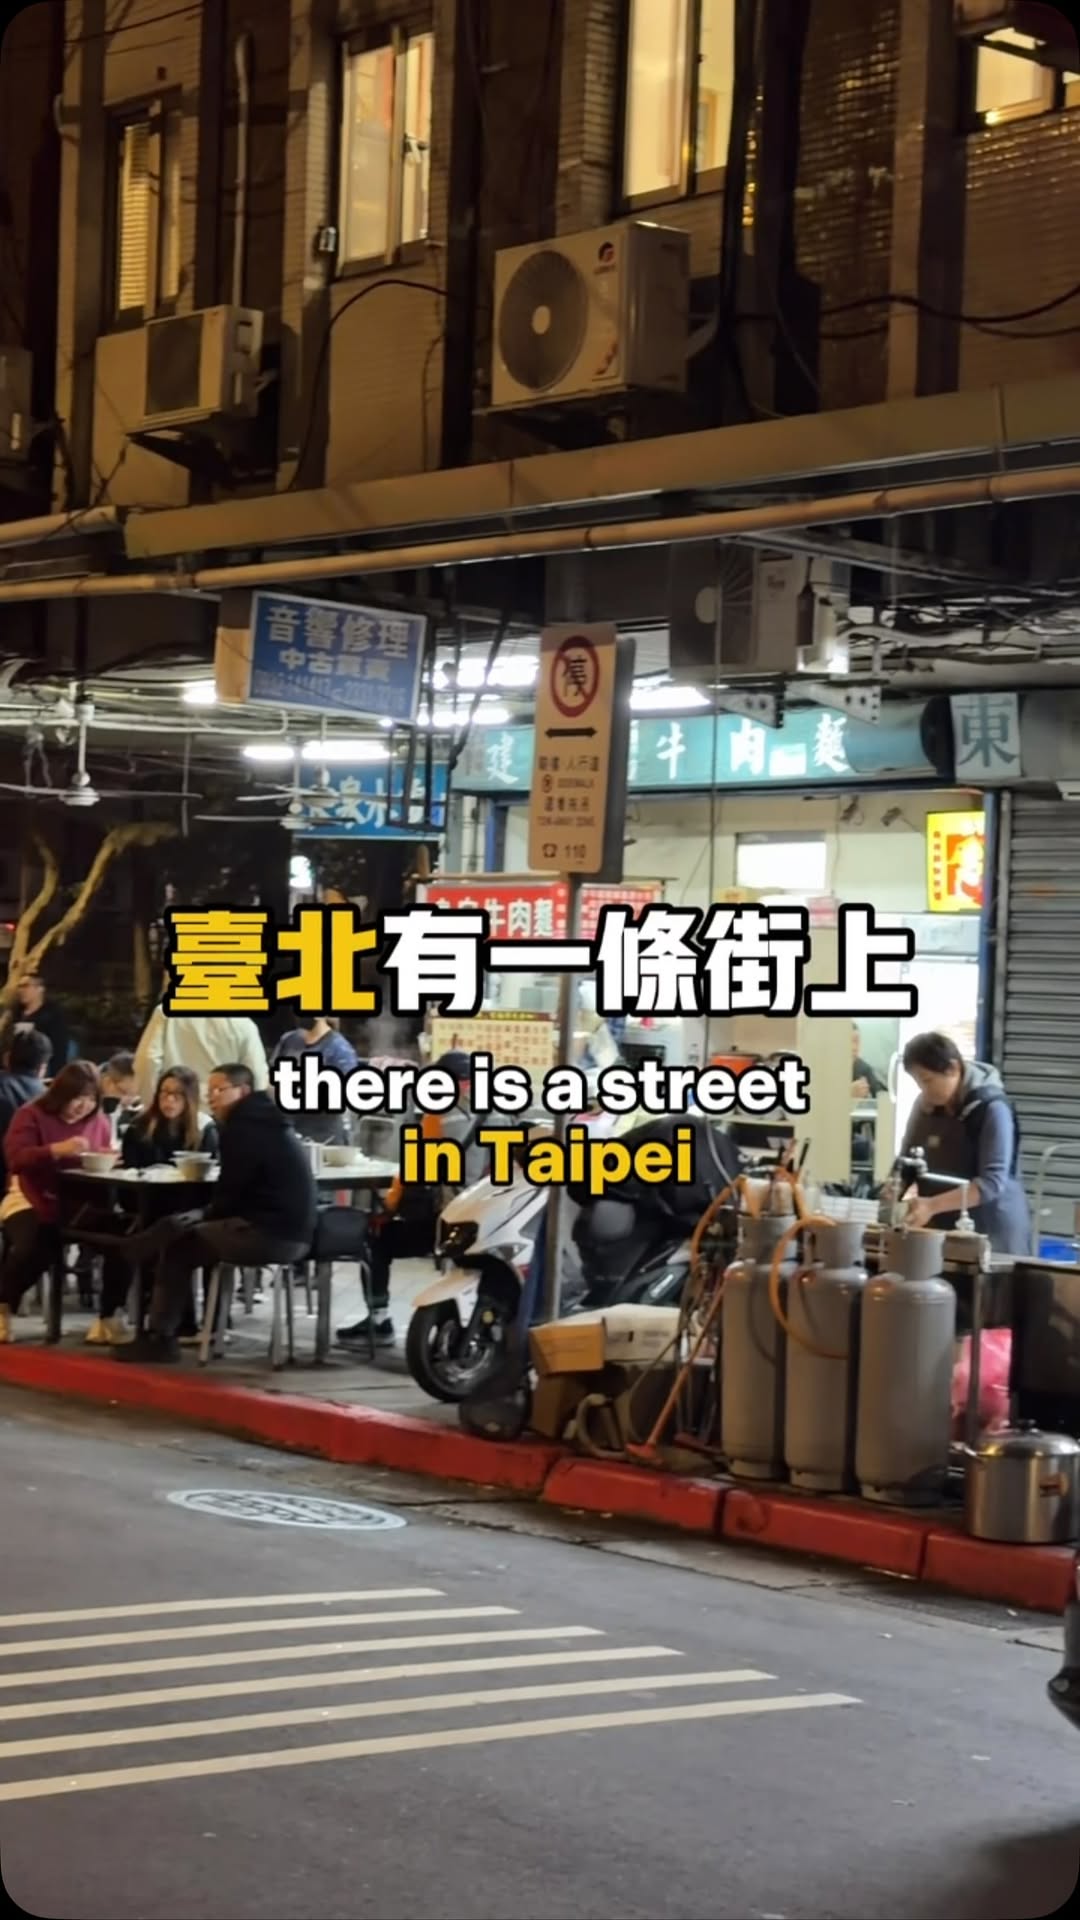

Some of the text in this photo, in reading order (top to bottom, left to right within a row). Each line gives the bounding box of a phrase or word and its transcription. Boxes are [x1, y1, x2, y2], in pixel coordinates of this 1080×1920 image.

[265, 605, 411, 660] 音響修理
[562, 653, 588, 698] 停
[956, 696, 1018, 768] 東
[434, 896, 555, 938] 牛肉麵
